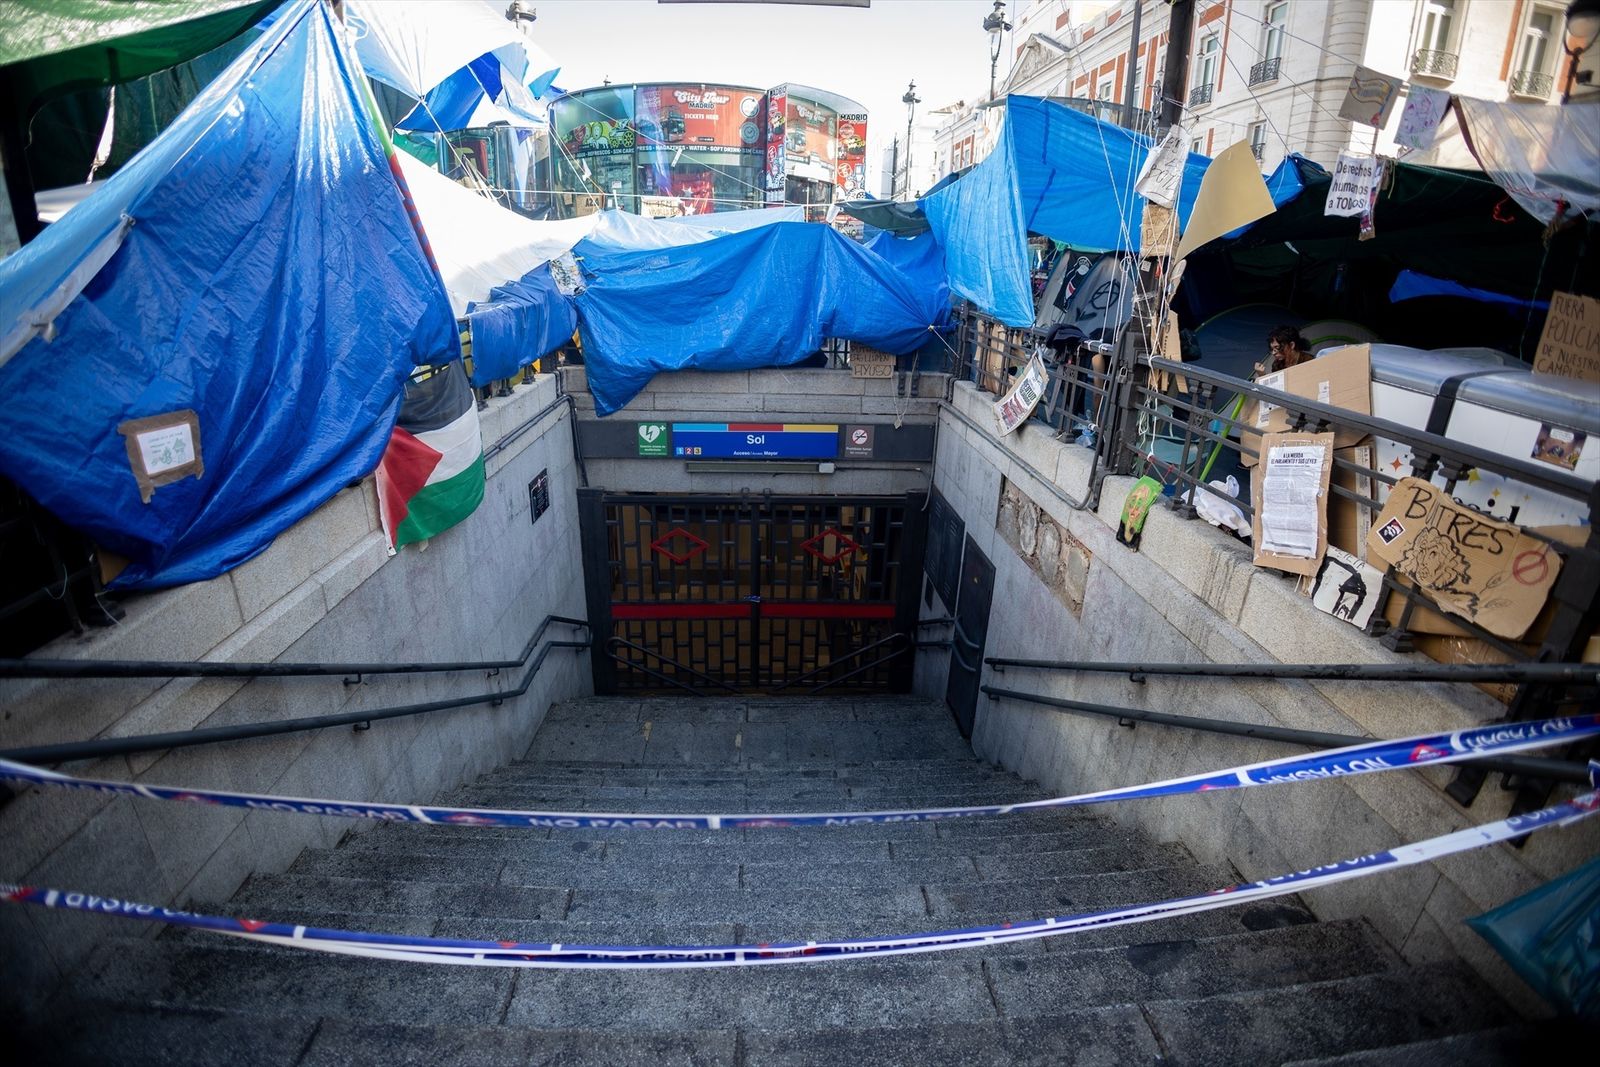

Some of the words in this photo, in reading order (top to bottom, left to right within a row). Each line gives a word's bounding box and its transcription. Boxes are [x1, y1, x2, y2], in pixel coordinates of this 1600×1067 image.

[675, 90, 698, 103] City
[702, 90, 729, 104] Tour
[1336, 161, 1372, 178] Derechos
[1332, 181, 1369, 196] humanos
[1328, 199, 1334, 209] a
[1554, 295, 1586, 320] FUERA
[1543, 343, 1553, 357] DE
[746, 434, 765, 445] Sol
[529, 818, 580, 827] NO
[590, 819, 697, 829] PASAR
